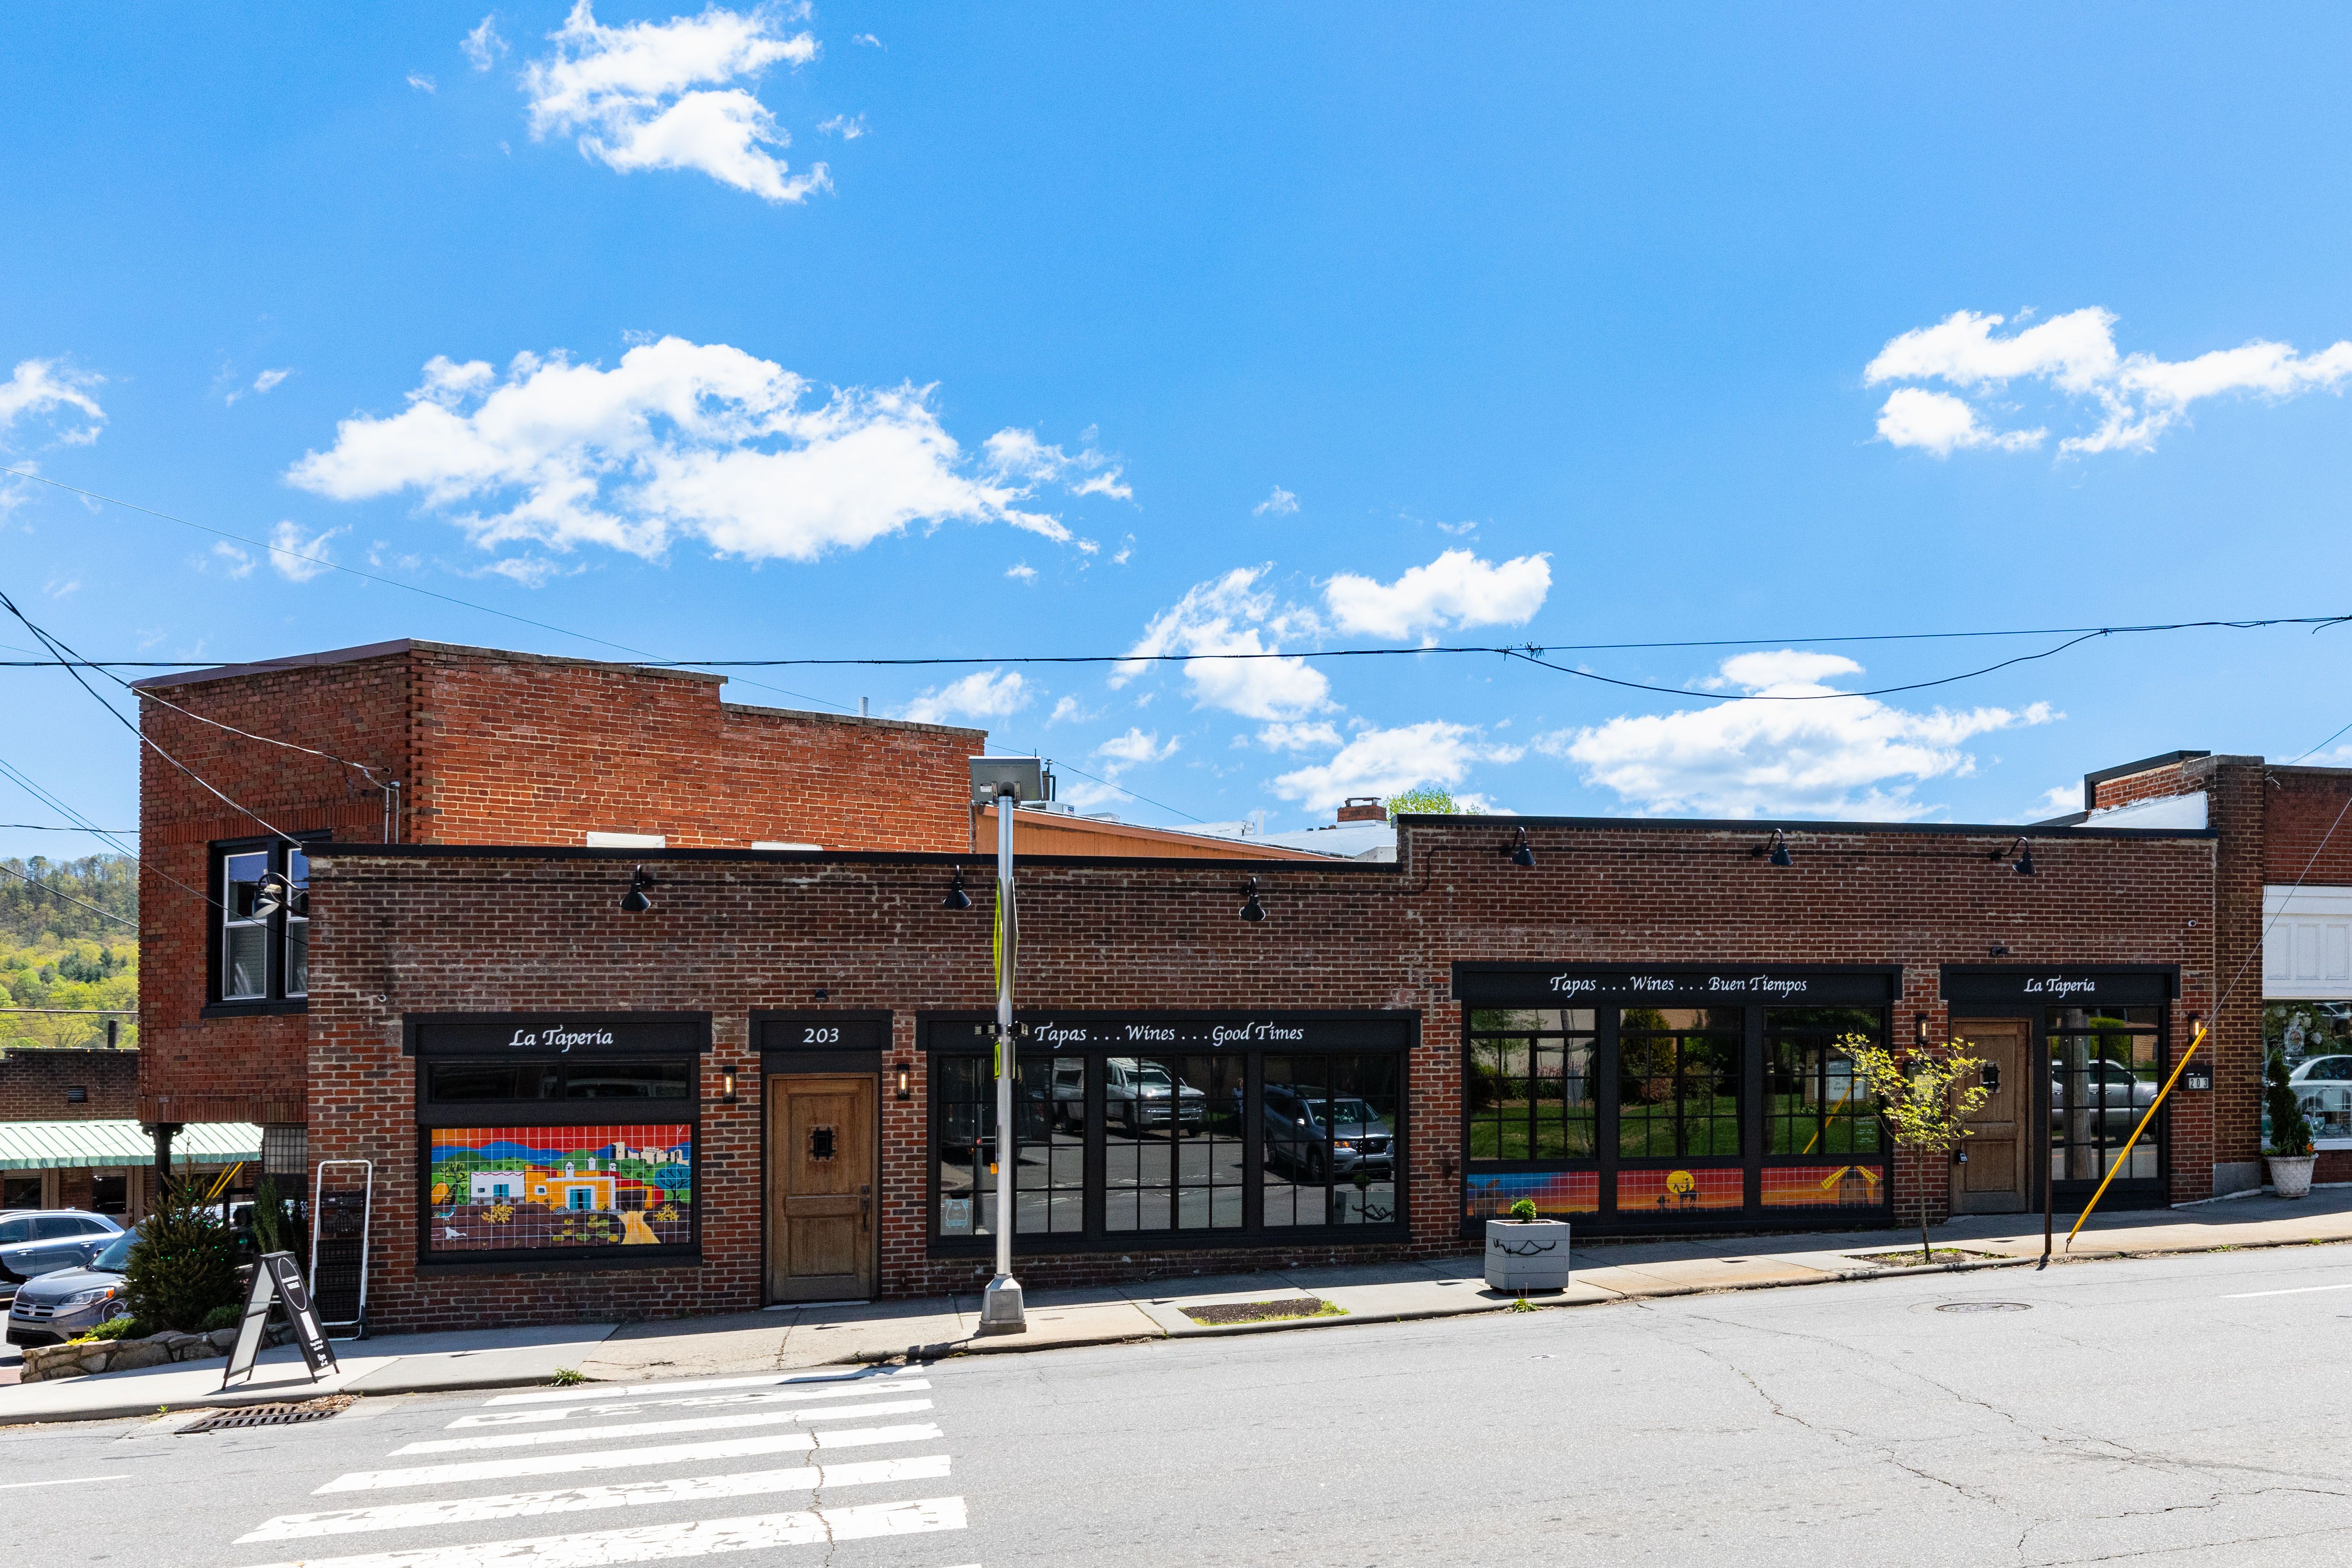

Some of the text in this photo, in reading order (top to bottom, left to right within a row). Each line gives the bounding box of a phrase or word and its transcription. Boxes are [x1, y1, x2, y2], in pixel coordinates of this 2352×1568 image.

[1550, 973, 1597, 999] Tapas
[1630, 976, 1674, 991] Wines
[1708, 976, 1746, 991] Buen
[1749, 974, 1807, 999] Tiempos
[2023, 978, 2043, 992] La
[508, 1029, 537, 1047] La
[803, 1028, 839, 1043] 203
[1034, 1021, 1087, 1049] Tapas
[1125, 1024, 1175, 1041] Wines
[1212, 1022, 1255, 1047] Good
[1255, 1021, 1305, 1040] Times
[2190, 1078, 2207, 1088] 203
